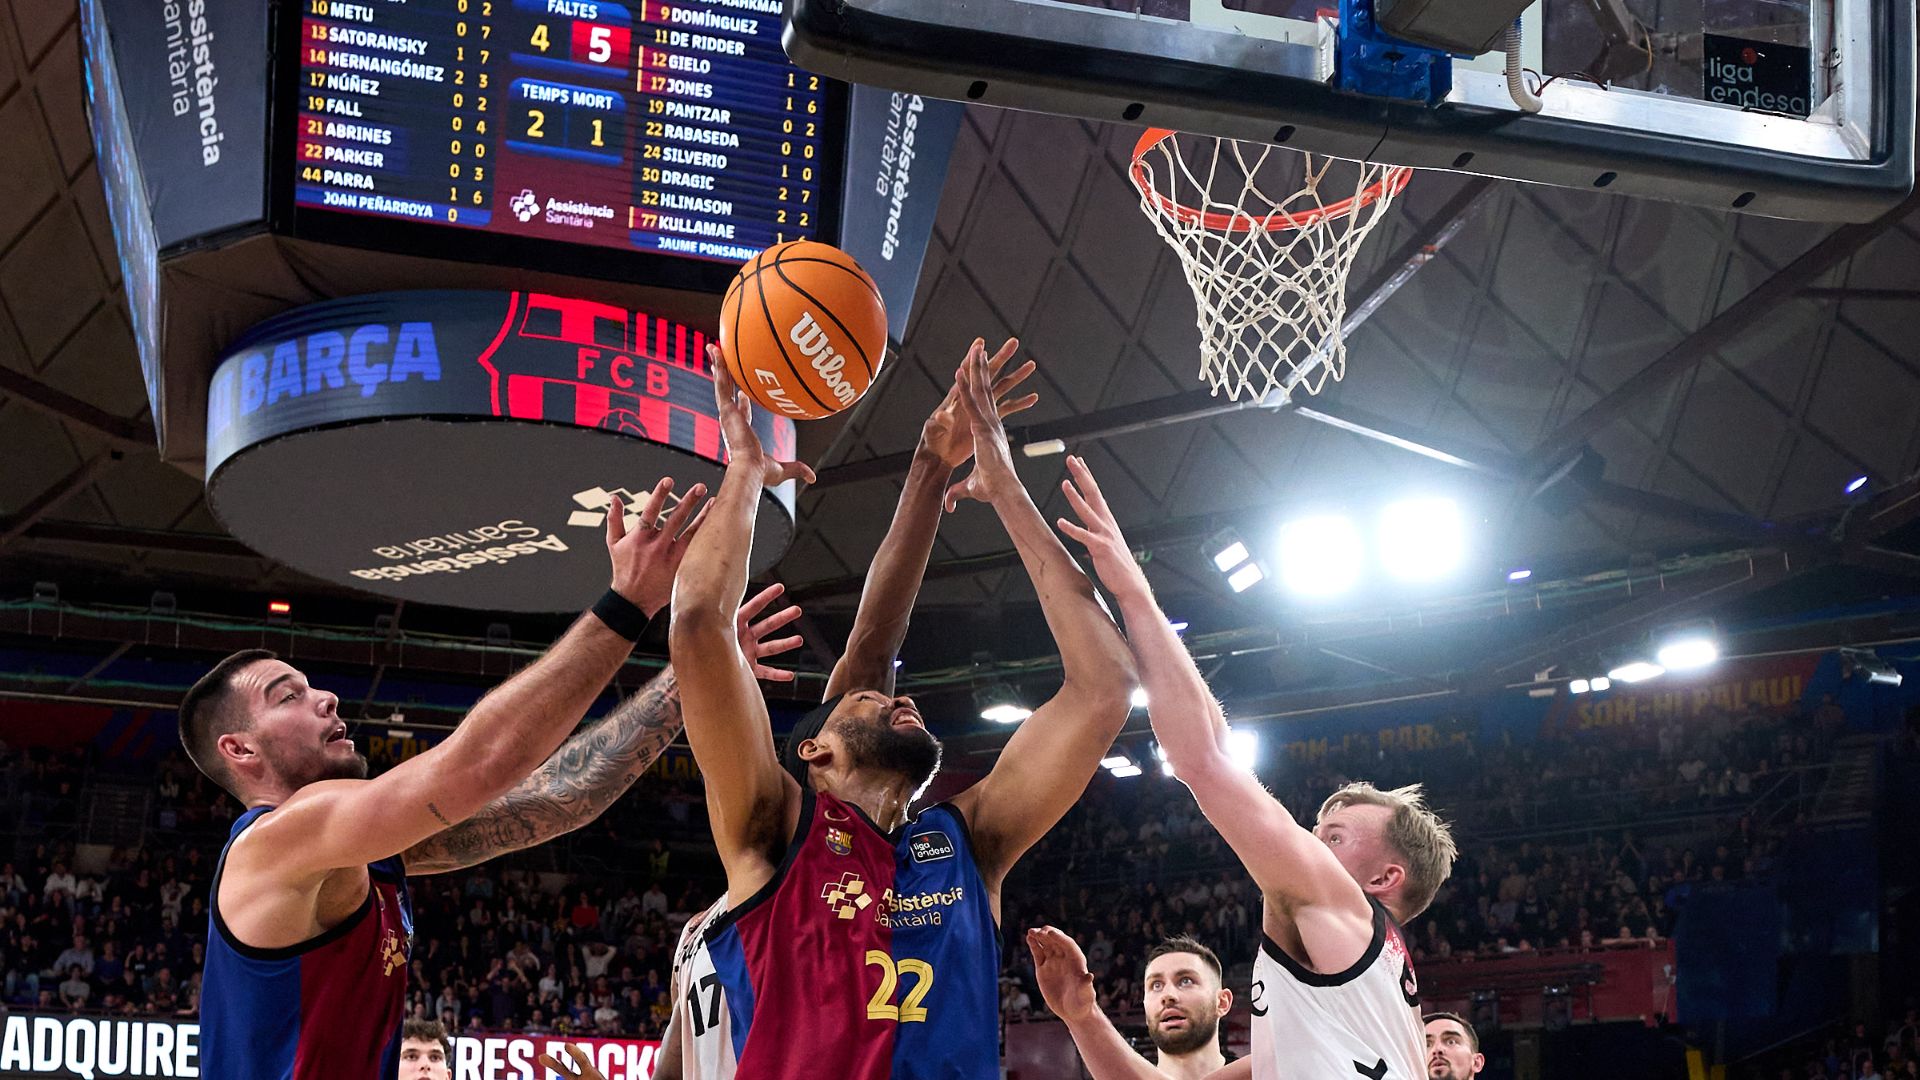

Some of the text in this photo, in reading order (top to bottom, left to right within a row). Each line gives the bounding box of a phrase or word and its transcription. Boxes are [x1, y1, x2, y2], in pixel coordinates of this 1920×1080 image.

[311, 0, 491, 40] 10 METU 0 7
[483, 4, 492, 16] 2
[547, 0, 598, 20] FALTES
[660, 7, 758, 35] 9 DOMÍNGUEZ
[163, 0, 194, 117] anitària
[329, 26, 428, 56] SATORANSKY
[456, 47, 464, 61] 1
[480, 50, 490, 64] 7
[530, 24, 612, 63] 4 5
[655, 29, 745, 56] 11 DE RIDDER
[188, 0, 225, 167] ssistència
[309, 48, 488, 88] 14 HERNANGÓMEZ 2 3
[651, 52, 818, 91] 12 GIELO 1 2
[1710, 57, 1753, 84] liga
[310, 72, 487, 111] 17 NÚÑEZ 0 2
[521, 83, 612, 110] TEMPS MORT
[651, 76, 817, 114] 17 JONES 1 6
[1710, 84, 1806, 114] endesa
[308, 96, 486, 135] 19 FALL 0 4
[526, 110, 604, 147] 2 1
[649, 99, 816, 137] 19 PANTZAR 0 2
[307, 120, 485, 158] 21 ABRINES 0 0
[646, 122, 814, 158] 22 RABASEDA 0 0
[876, 92, 903, 197] anitària
[305, 144, 484, 182] 22 PARKER 0 3
[643, 144, 812, 182] 24 SILVERIO 1 0
[881, 94, 925, 261] Assistència
[302, 167, 483, 205] 44 PARRA 1 6
[642, 167, 810, 204] 30 DRAGIC 2 7
[324, 191, 458, 222] JOAN PEÑARROYA 0
[545, 211, 594, 229] Sanitària
[546, 197, 615, 219] Assistència
[641, 191, 809, 227] 32 HLINASON 2 2
[641, 213, 658, 229] 77
[659, 215, 735, 239] KULLAMAE
[658, 236, 697, 253] JAUME
[240, 321, 442, 416] BARÇA
[577, 347, 670, 397] FCB
[790, 311, 857, 406] Wilson
[350, 534, 569, 581] Assistència
[372, 519, 540, 559] Sanitària
[913, 842, 930, 851] liga
[917, 846, 951, 858] endesa
[875, 903, 942, 928] Sanitària
[687, 972, 722, 1038] 17
[865, 949, 934, 1023] 22
